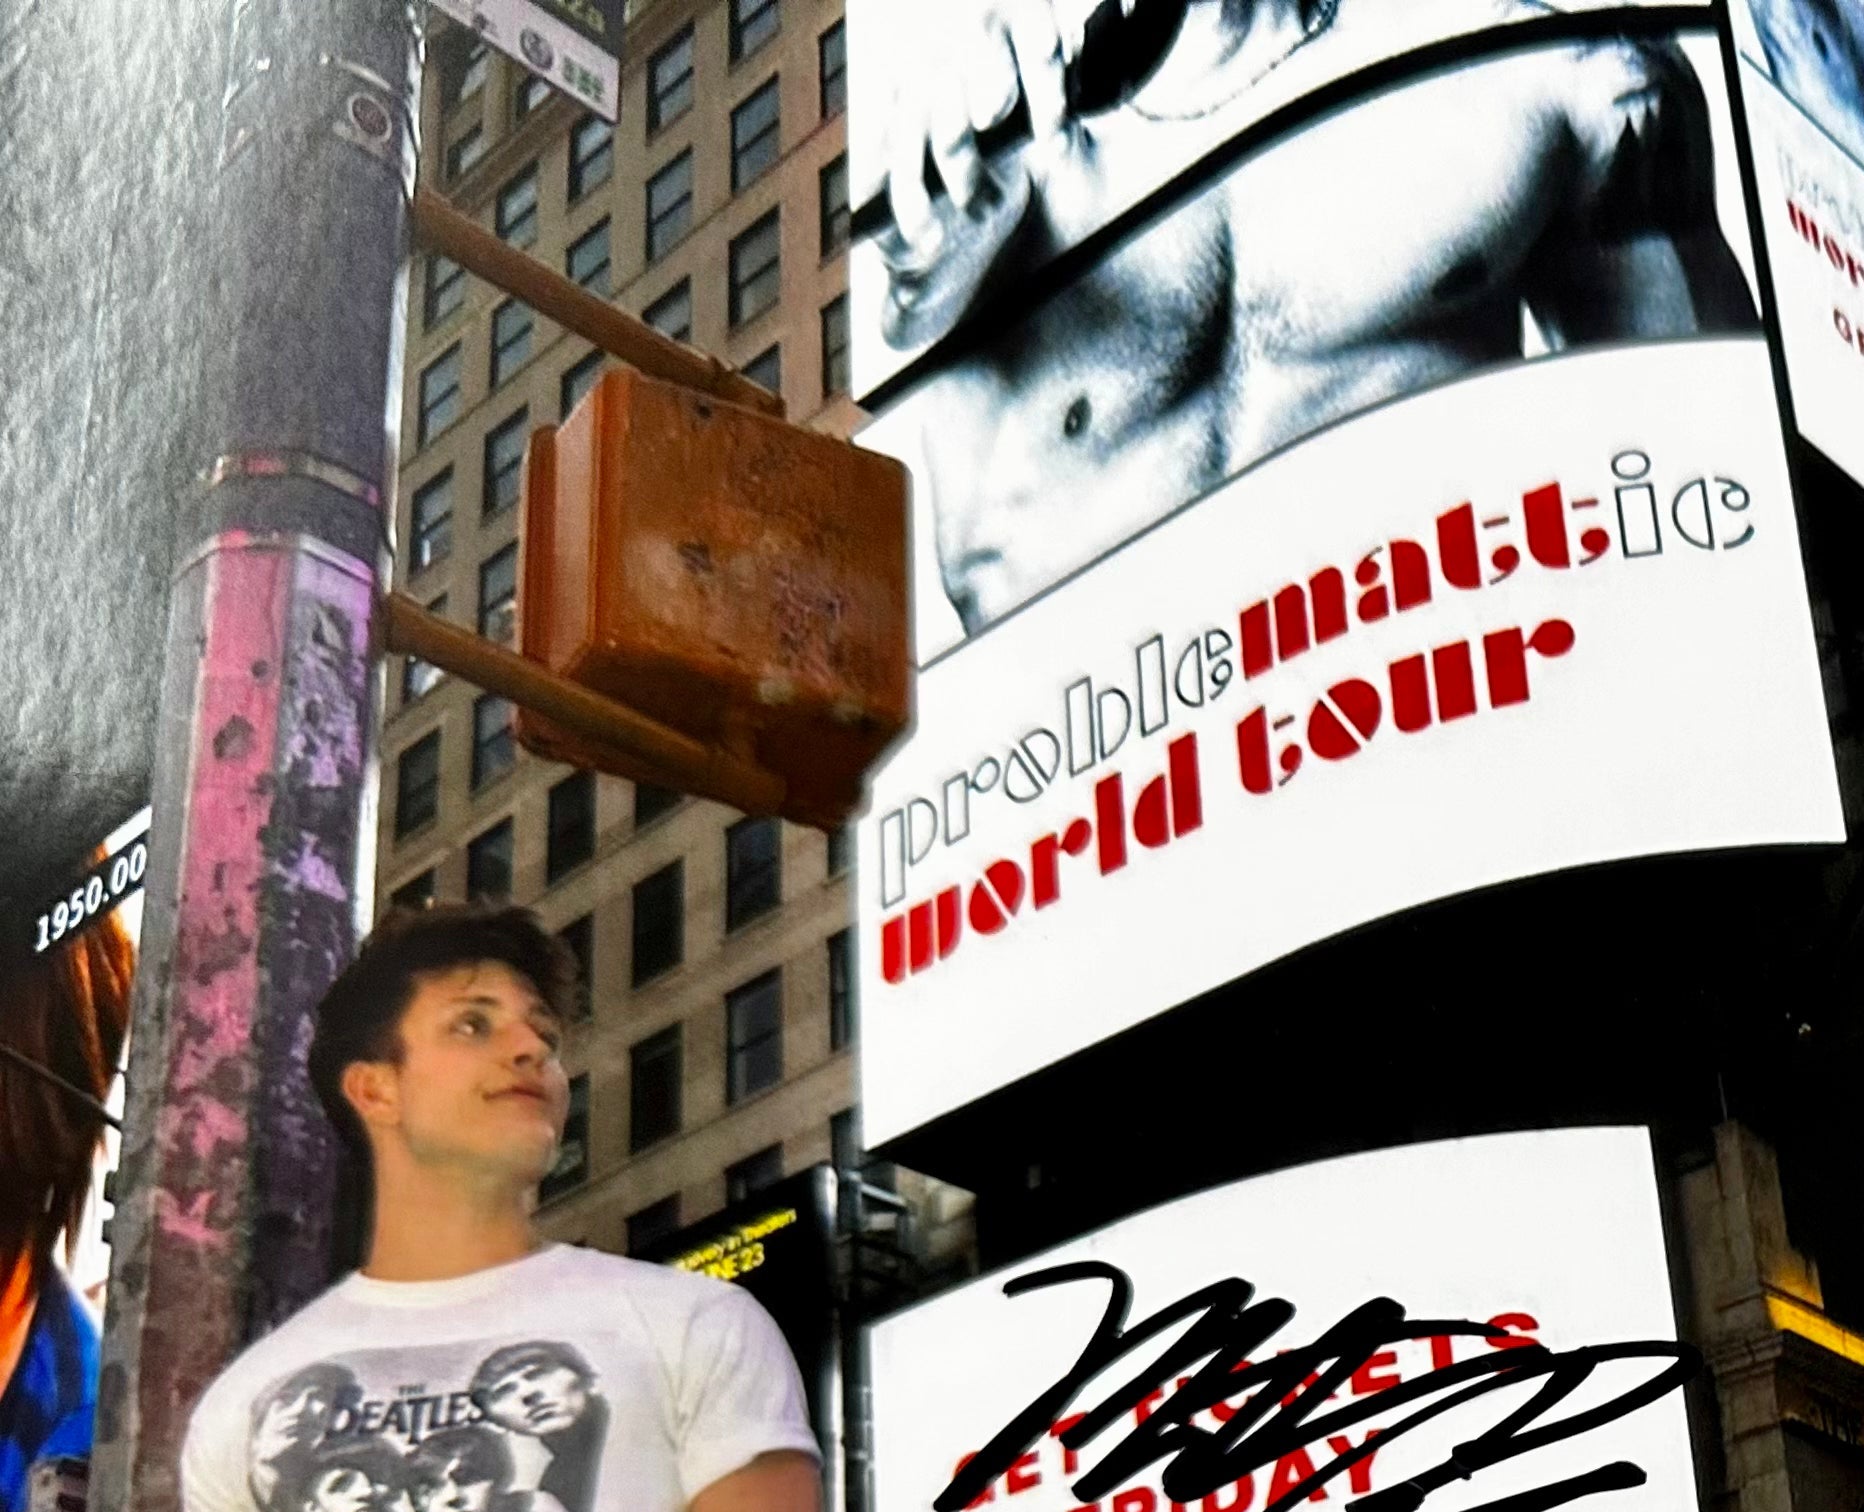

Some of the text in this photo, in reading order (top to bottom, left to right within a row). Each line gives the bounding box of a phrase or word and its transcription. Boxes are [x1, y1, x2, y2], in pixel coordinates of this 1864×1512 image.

[878, 448, 1756, 909] problemattic
[879, 617, 1576, 986] world tour
[36, 843, 148, 953] 1950.00
